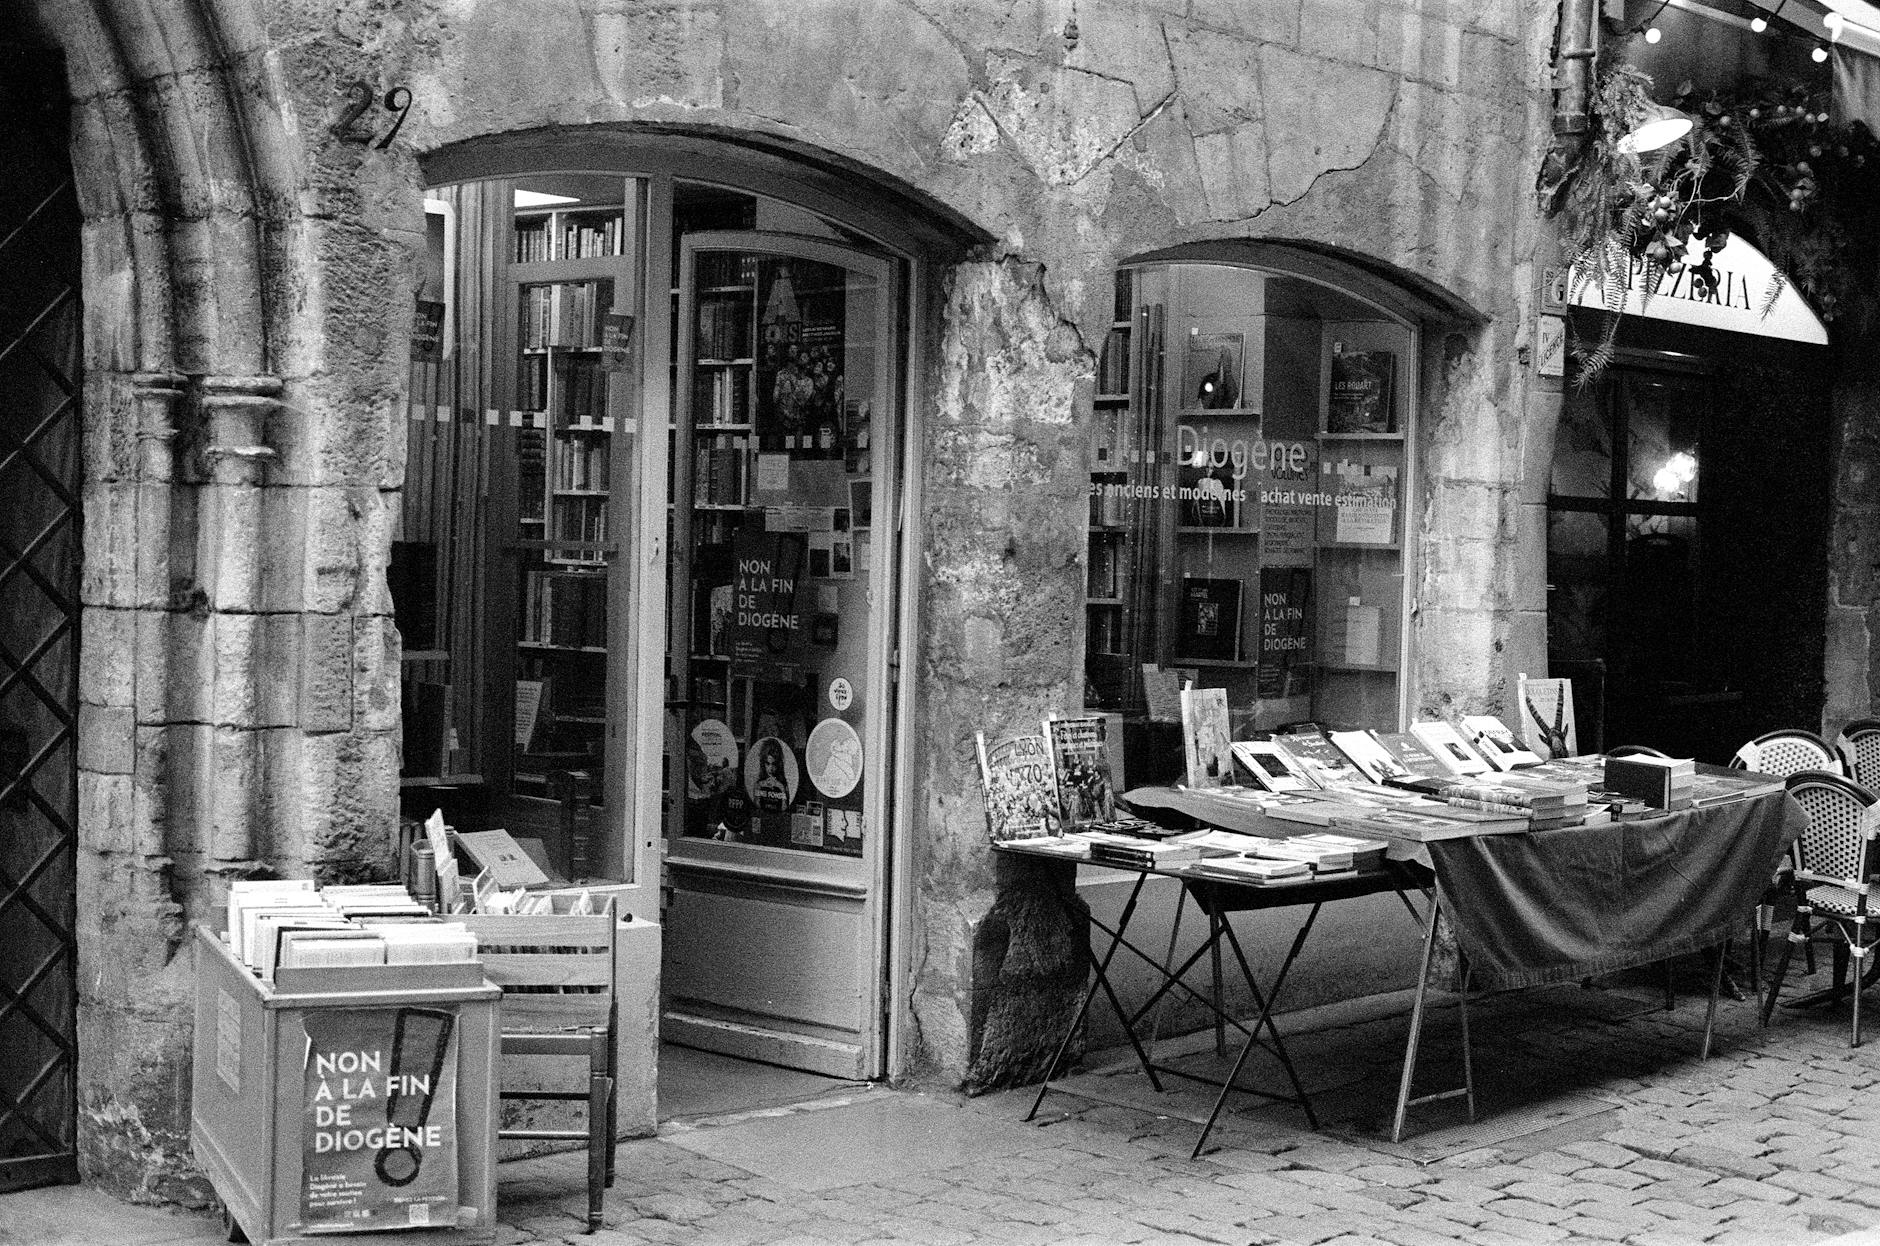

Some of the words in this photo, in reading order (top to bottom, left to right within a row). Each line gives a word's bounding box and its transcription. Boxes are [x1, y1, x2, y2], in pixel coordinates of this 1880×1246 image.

[329, 80, 412, 150] 29
[1104, 479, 1159, 499] anciens
[1162, 484, 1176, 500] et
[1179, 480, 1246, 502] modenes
[1261, 486, 1296, 505] achat
[1298, 491, 1333, 507] vente
[1334, 492, 1397, 510] estimation
[739, 559, 771, 575] NON
[751, 577, 767, 593] LA
[771, 578, 794, 594] FIN
[738, 594, 756, 610] DE
[1264, 592, 1287, 606] NON
[1273, 607, 1285, 621] LA
[1287, 607, 1303, 620] FIN
[1264, 623, 1277, 636] DE
[316, 1050, 381, 1075] NON
[315, 1073, 334, 1102] À
[343, 1078, 376, 1100] LA
[386, 1074, 430, 1097] FIN
[316, 1104, 351, 1128] DE
[315, 1122, 442, 1154] DIOGÈNE
